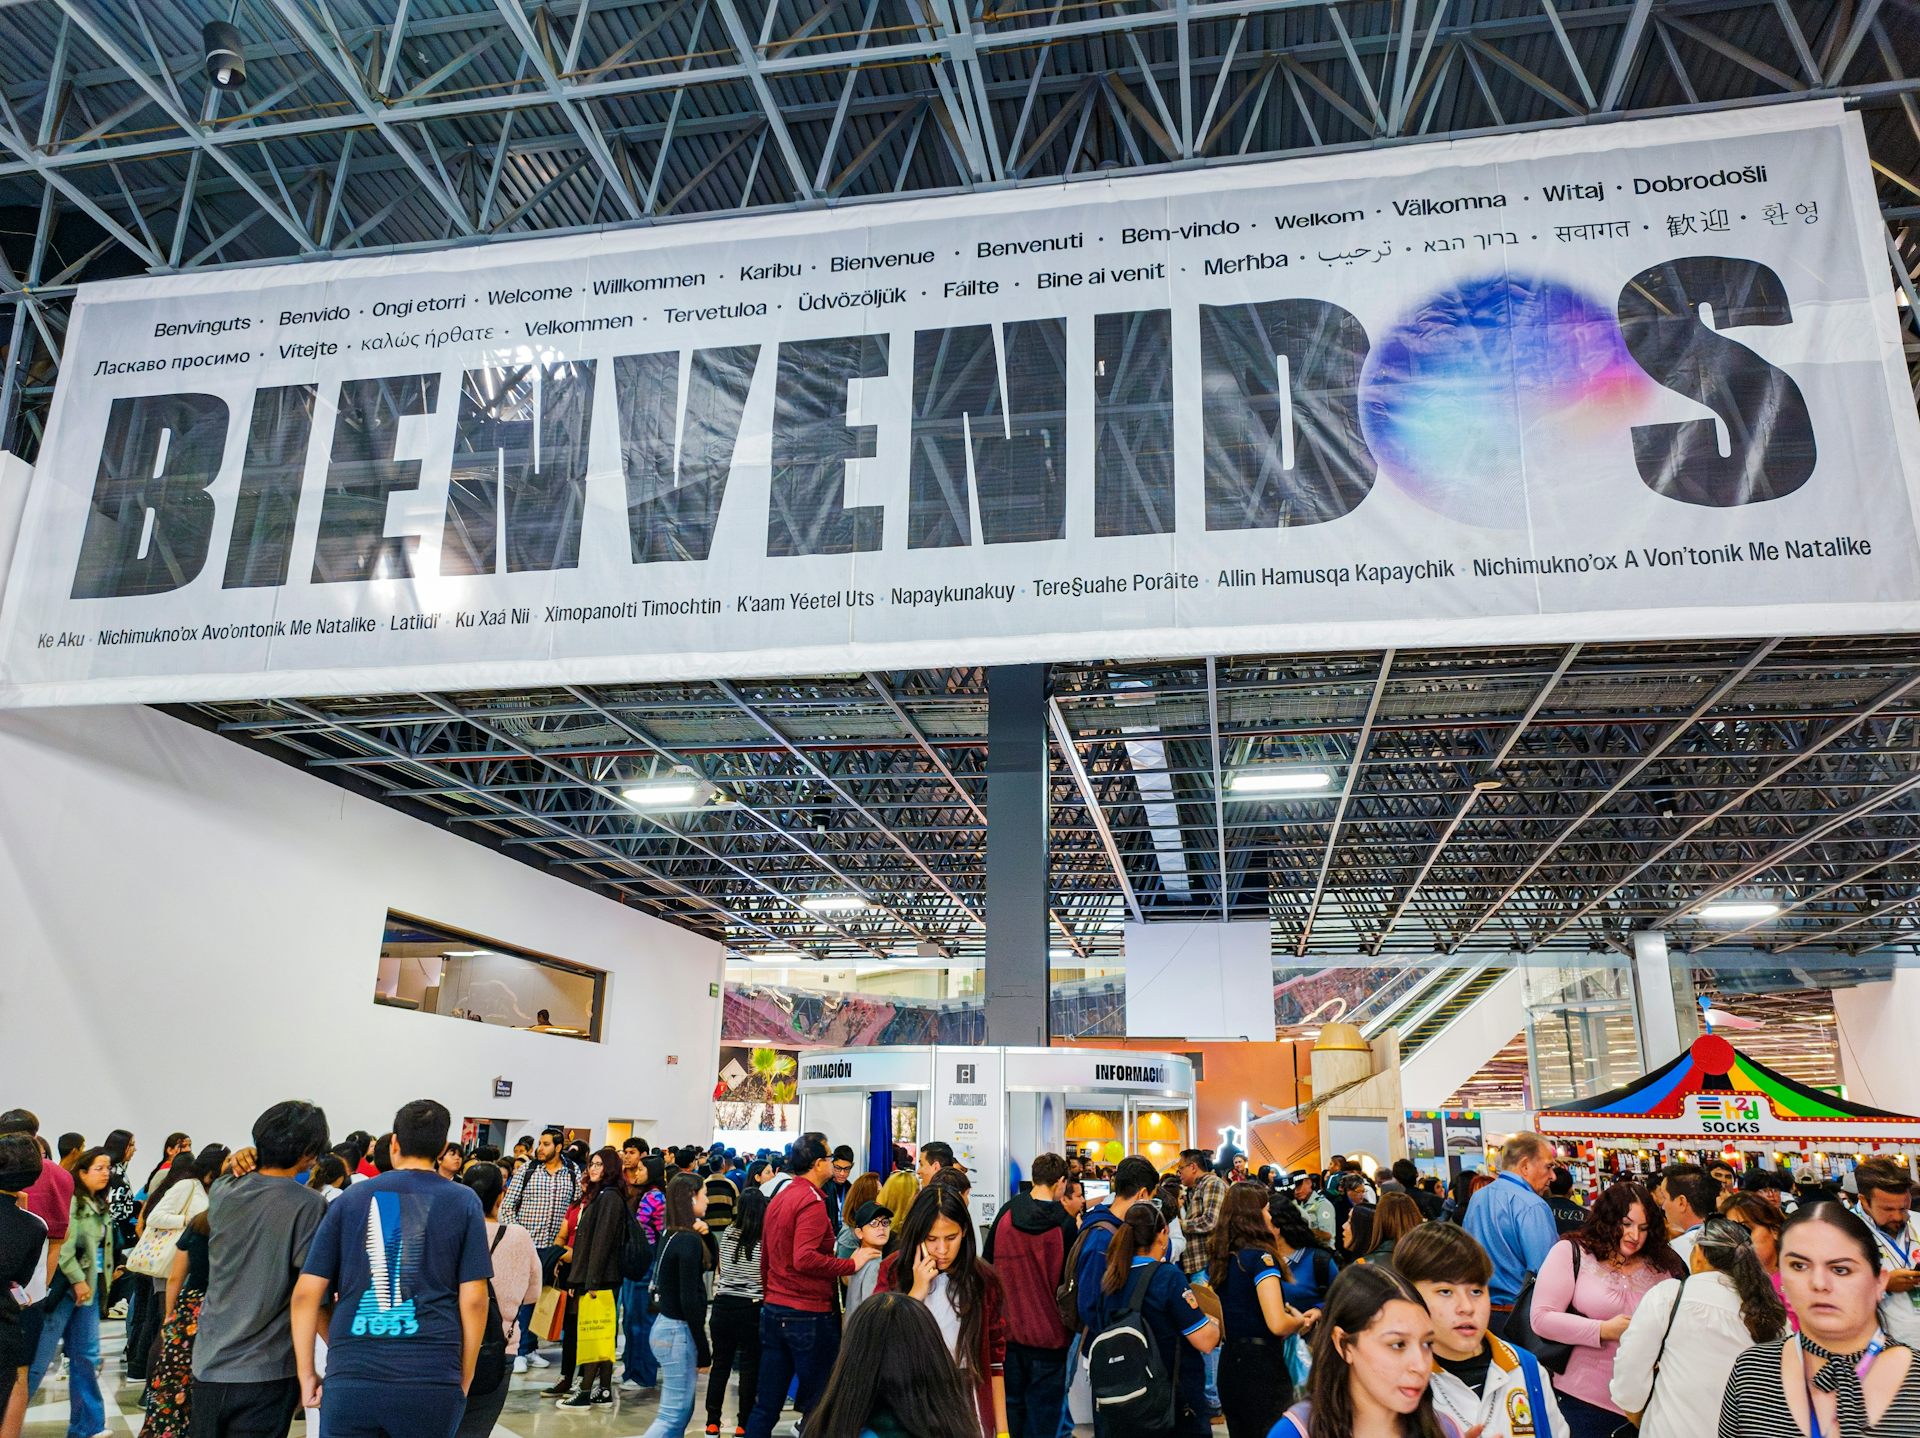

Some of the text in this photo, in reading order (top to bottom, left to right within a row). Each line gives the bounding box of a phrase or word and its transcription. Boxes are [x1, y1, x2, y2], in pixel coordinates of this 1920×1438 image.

[153, 165, 1768, 338] Benvinguts Benvido Ongi etorri Welcome Willkommen Karibu Bienvenue Benvenuti Bem-vindo Welkom Välkomna Witaj Dobrodošli
[1318, 240, 1392, 268] ترحيب
[1424, 231, 1520, 253] ברוך הבא
[524, 315, 633, 337] Velkommen
[663, 300, 767, 324] Tervetuloa
[798, 287, 907, 312] Üdvözöljük
[943, 279, 1000, 299] Fáilte
[1037, 270, 1083, 290] Bine
[1088, 267, 1106, 285] ai
[1110, 262, 1166, 283] venit
[279, 340, 338, 360] Vítejte
[361, 325, 494, 351] καλώς ήρθατε
[93, 350, 251, 377] Ласкаво просимо
[37, 632, 55, 649] Ke
[56, 631, 86, 648] Aku
[289, 619, 312, 636] Me
[315, 616, 376, 634] Natalike
[455, 611, 475, 628] Ku
[478, 608, 507, 627] Xaá
[511, 608, 530, 625] Nii
[544, 601, 638, 624] Ximopanolti
[641, 597, 721, 617] Timochtin
[789, 590, 841, 610] Yéetel
[845, 589, 874, 608] Uts
[891, 582, 1016, 608] Napaykunakuy
[1217, 567, 1256, 588] Allin
[1261, 565, 1350, 587] Hamusqa
[1355, 559, 1456, 585] Kapaychik
[1624, 549, 1640, 569] A
[1748, 541, 1780, 561] Me
[1784, 536, 1872, 560] Natalike
[1702, 1121, 1760, 1133] SOCKS
